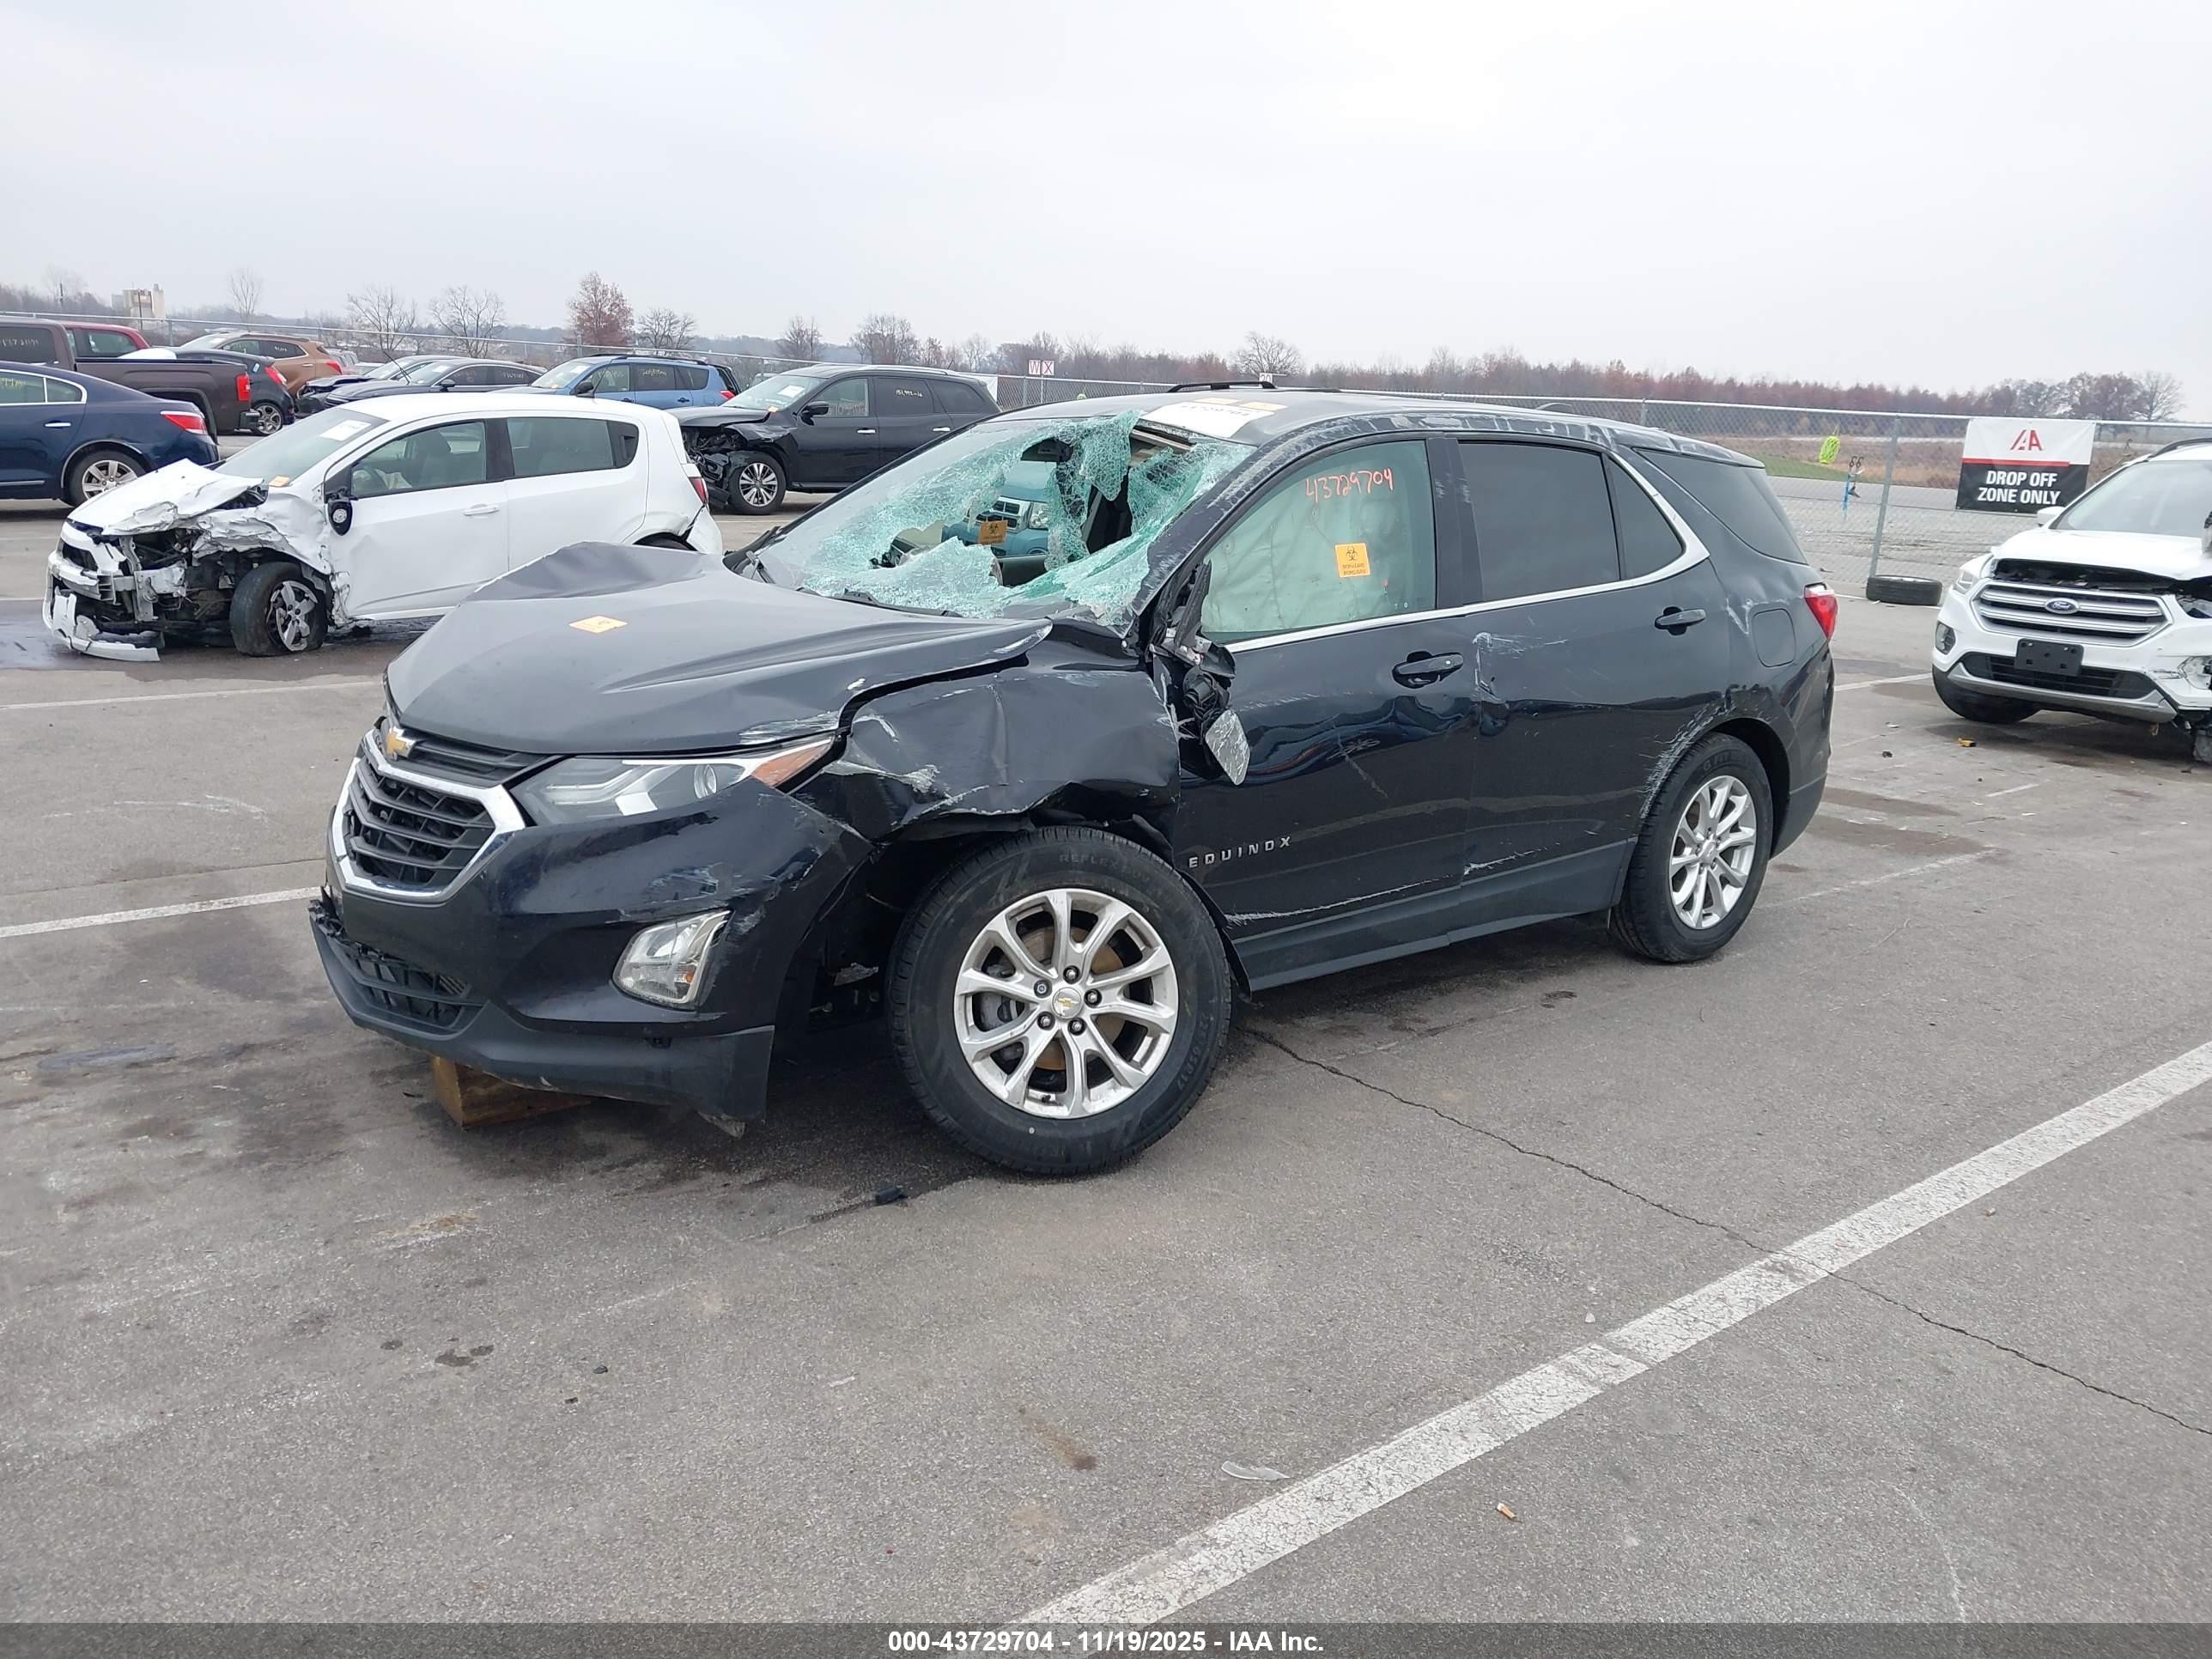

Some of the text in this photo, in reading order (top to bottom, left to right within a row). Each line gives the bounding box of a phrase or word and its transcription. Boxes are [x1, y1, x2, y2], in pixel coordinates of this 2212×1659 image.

[1030, 362, 1040, 374] W
[1043, 362, 1053, 374] X
[1305, 468, 1394, 503] 43729704
[1986, 471, 2058, 487] DROP OFF
[1978, 487, 2061, 505] ZONE ONLY
[1189, 836, 1291, 868] EQUINOX
